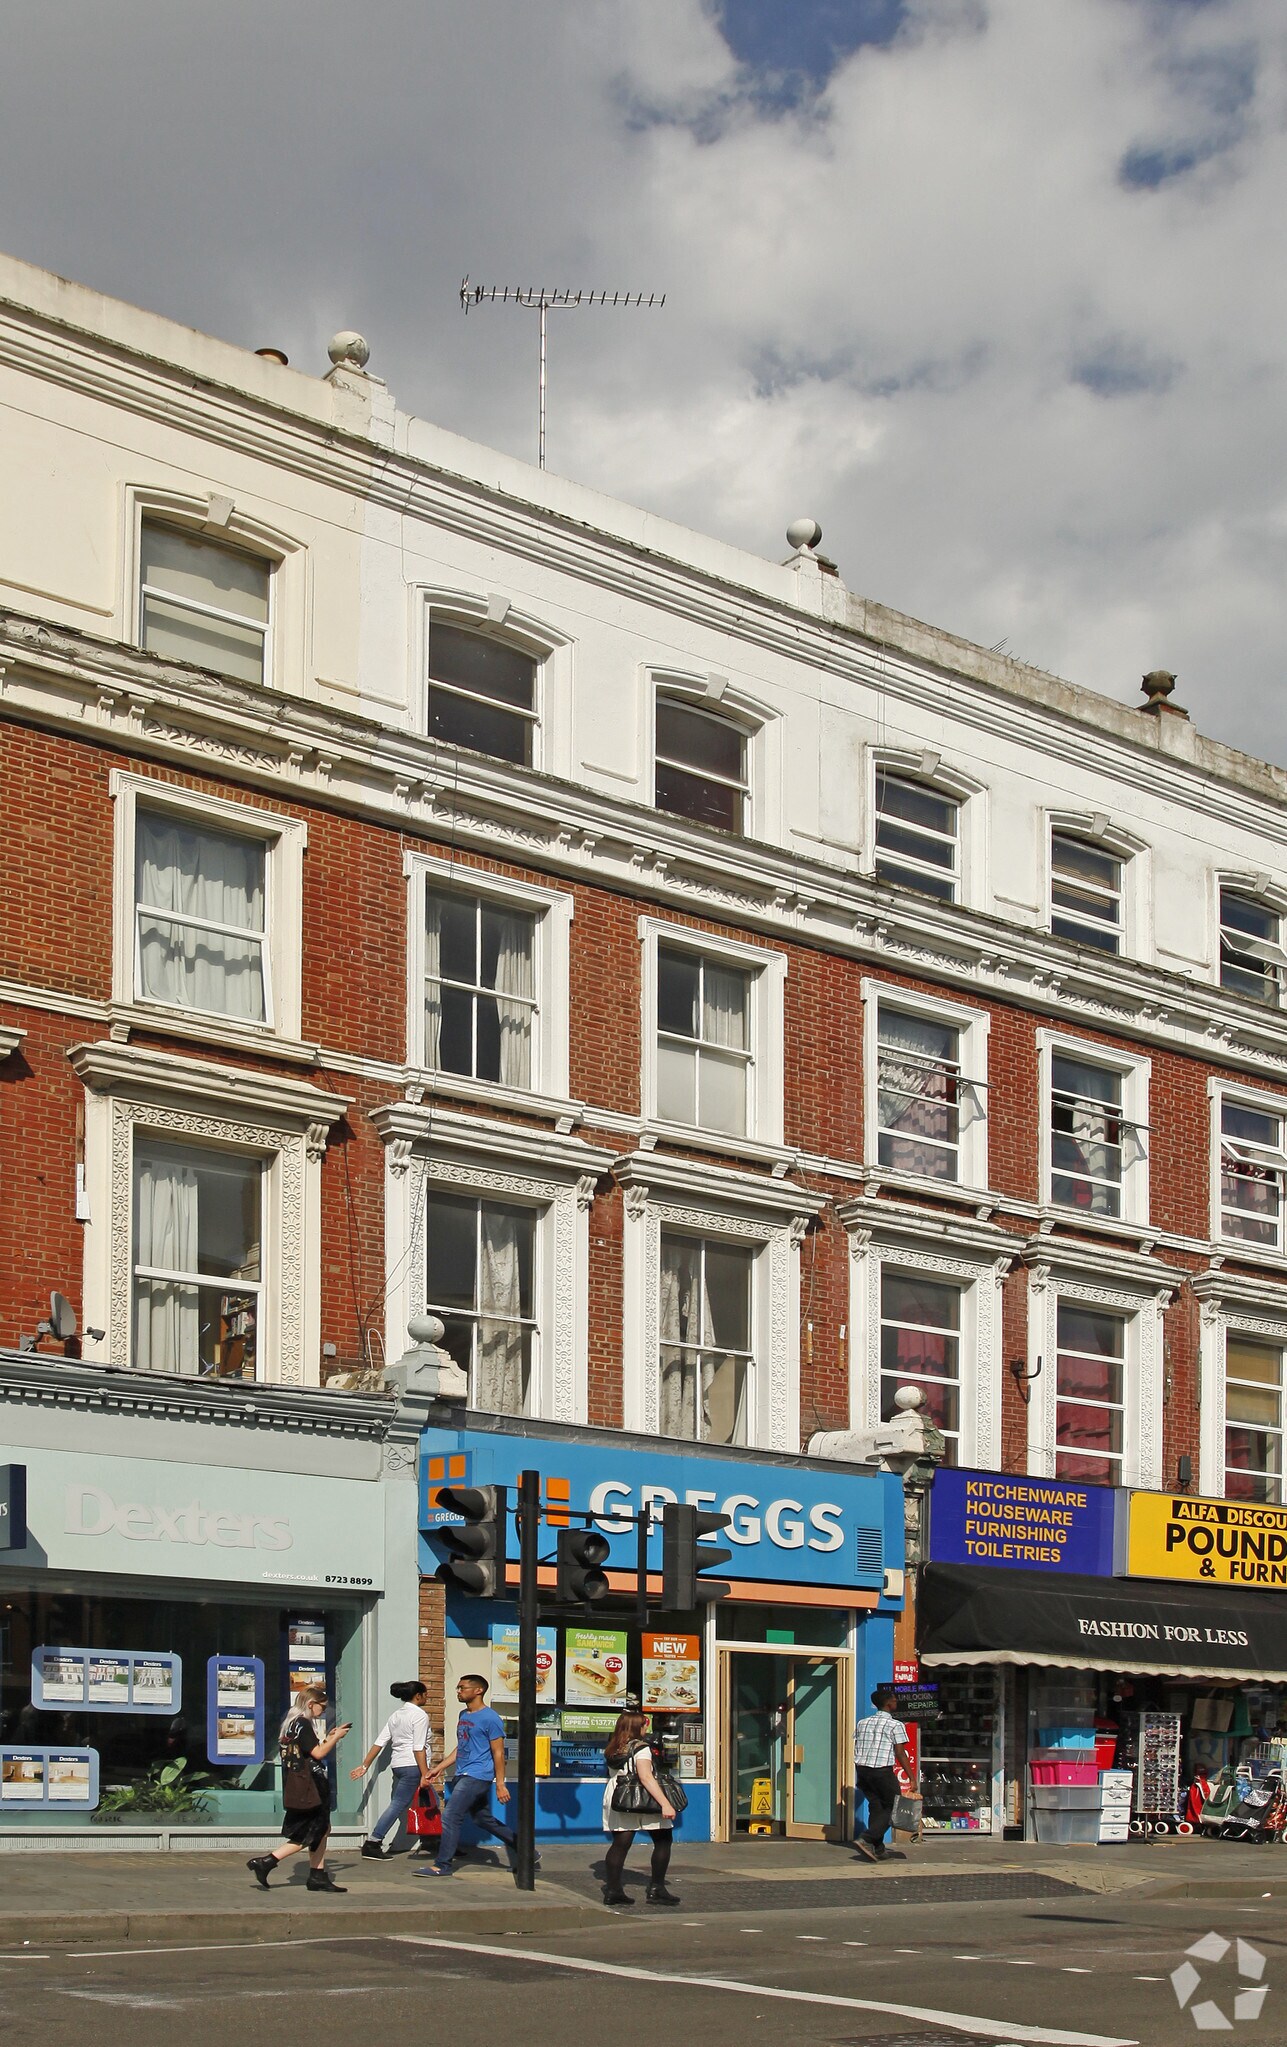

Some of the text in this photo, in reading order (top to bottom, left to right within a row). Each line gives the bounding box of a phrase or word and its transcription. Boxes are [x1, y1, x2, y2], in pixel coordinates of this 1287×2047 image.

[966, 1481, 1087, 1508] KITCHENWARE
[64, 1483, 293, 1551] Dexters
[588, 1481, 844, 1552] GREGGS
[966, 1500, 1073, 1526] HOUSEWARE
[1178, 1503, 1287, 1529] ALFA DISCOU
[965, 1520, 1067, 1544] FURNISHING
[1166, 1523, 1287, 1562] POUND
[965, 1540, 1061, 1563] TOILETRIES
[262, 1571, 373, 1586] dexters.co.uk 8723 8899
[1199, 1558, 1287, 1584] & FURN
[576, 1640, 614, 1648] SANDWICH
[1078, 1619, 1249, 1646] FASHION FOR LESS
[653, 1641, 687, 1654] NEW
[918, 1683, 938, 1692] PHONE
[907, 1701, 938, 1709] REPAIRS
